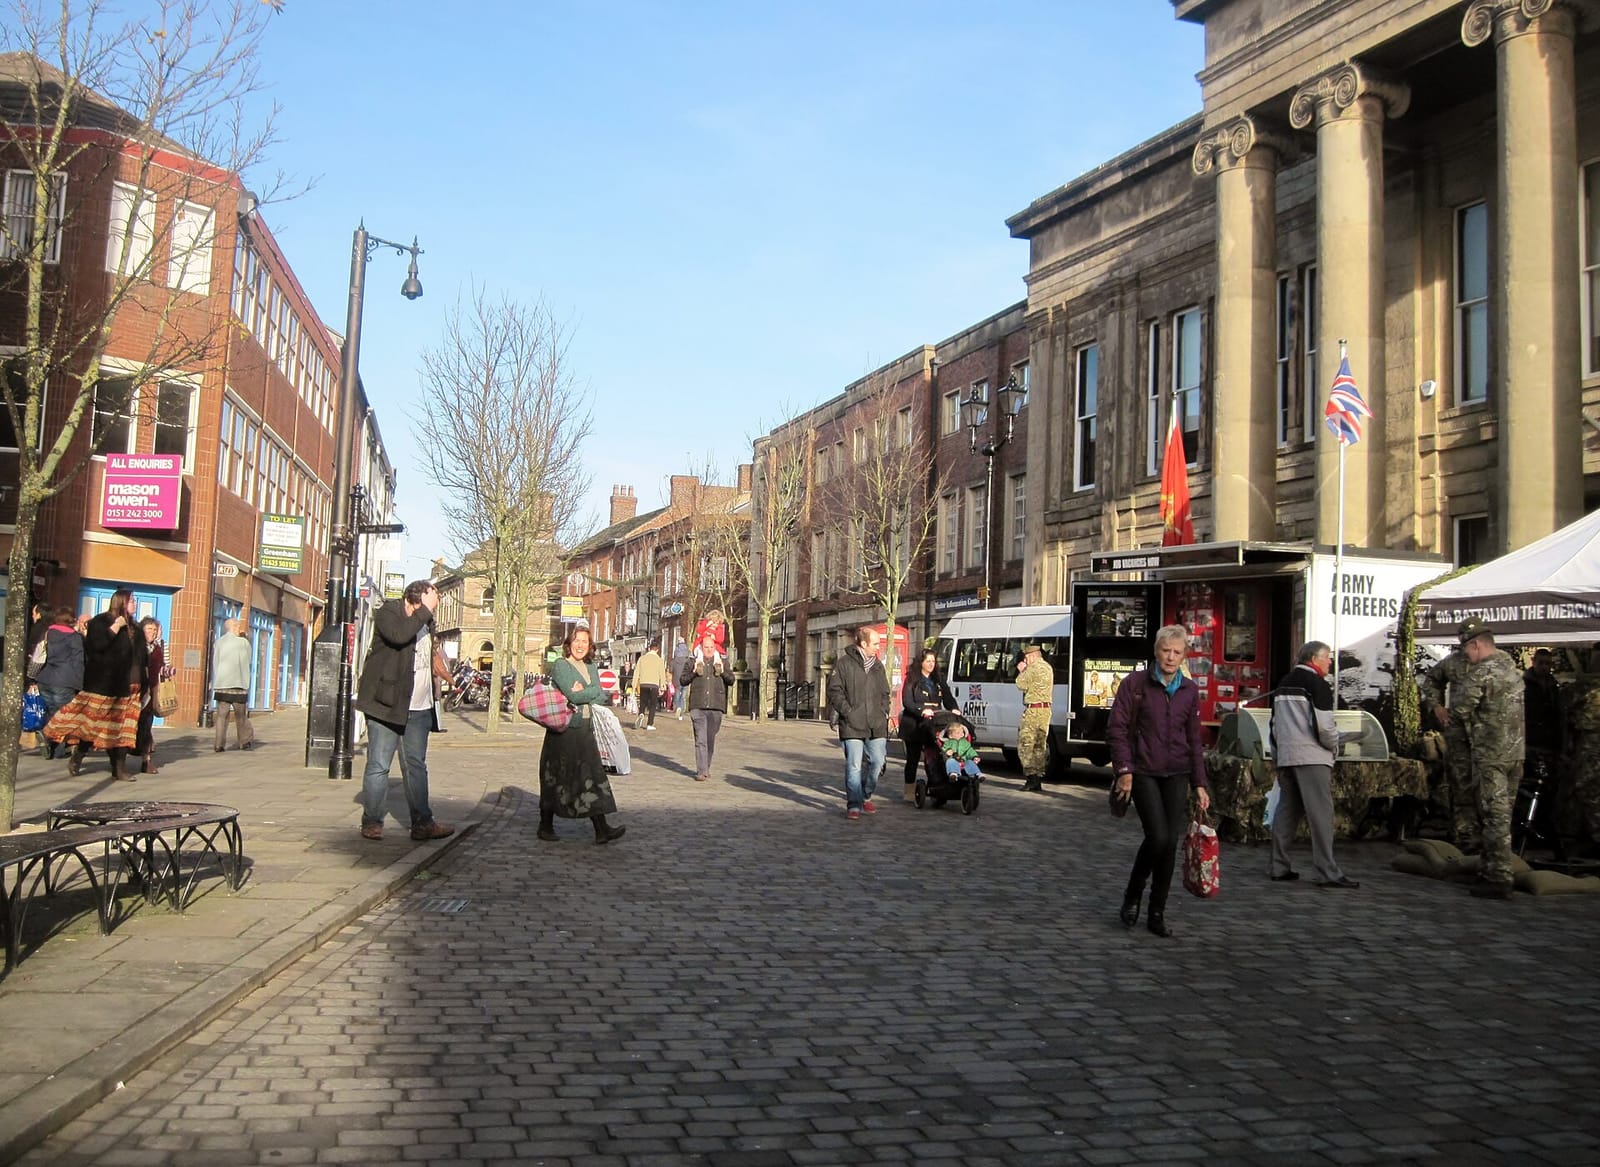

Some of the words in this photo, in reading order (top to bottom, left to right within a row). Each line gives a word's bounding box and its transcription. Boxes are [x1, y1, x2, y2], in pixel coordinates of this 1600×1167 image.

[111, 458, 126, 468] ALL
[128, 459, 173, 470] ENQUIRIES
[108, 483, 160, 496] mason
[106, 509, 125, 517] 0151
[126, 510, 141, 518] 242
[142, 510, 163, 519] 3000
[283, 517, 297, 525] LET
[263, 548, 298, 558] Greenham
[1331, 572, 1375, 595] ARMY
[1331, 594, 1397, 618] CAREERS
[1435, 610, 1452, 624] 4th
[1453, 606, 1518, 623] BATTALION
[1520, 604, 1545, 620] THE
[963, 701, 988, 717] ARMY
